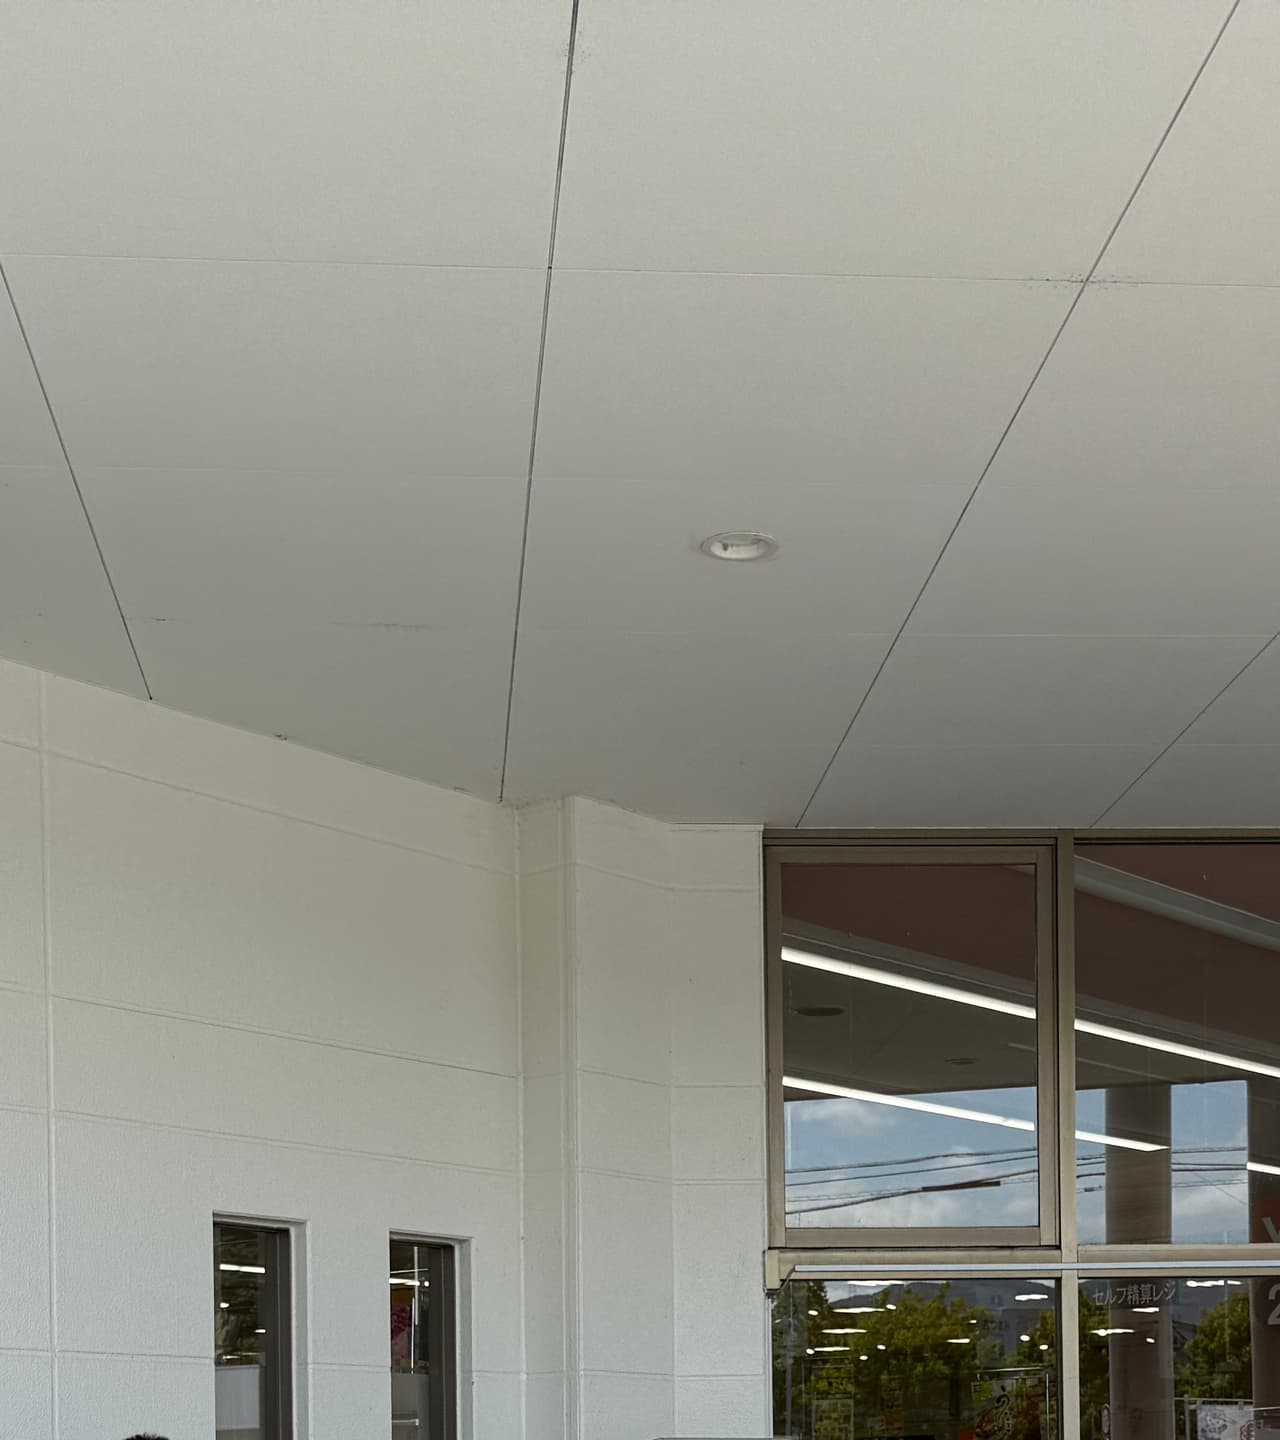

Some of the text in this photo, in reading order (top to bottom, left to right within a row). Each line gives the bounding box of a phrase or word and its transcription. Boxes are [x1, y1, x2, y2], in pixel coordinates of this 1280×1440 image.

[1093, 1282, 1176, 1305] セルフ精算レジ
